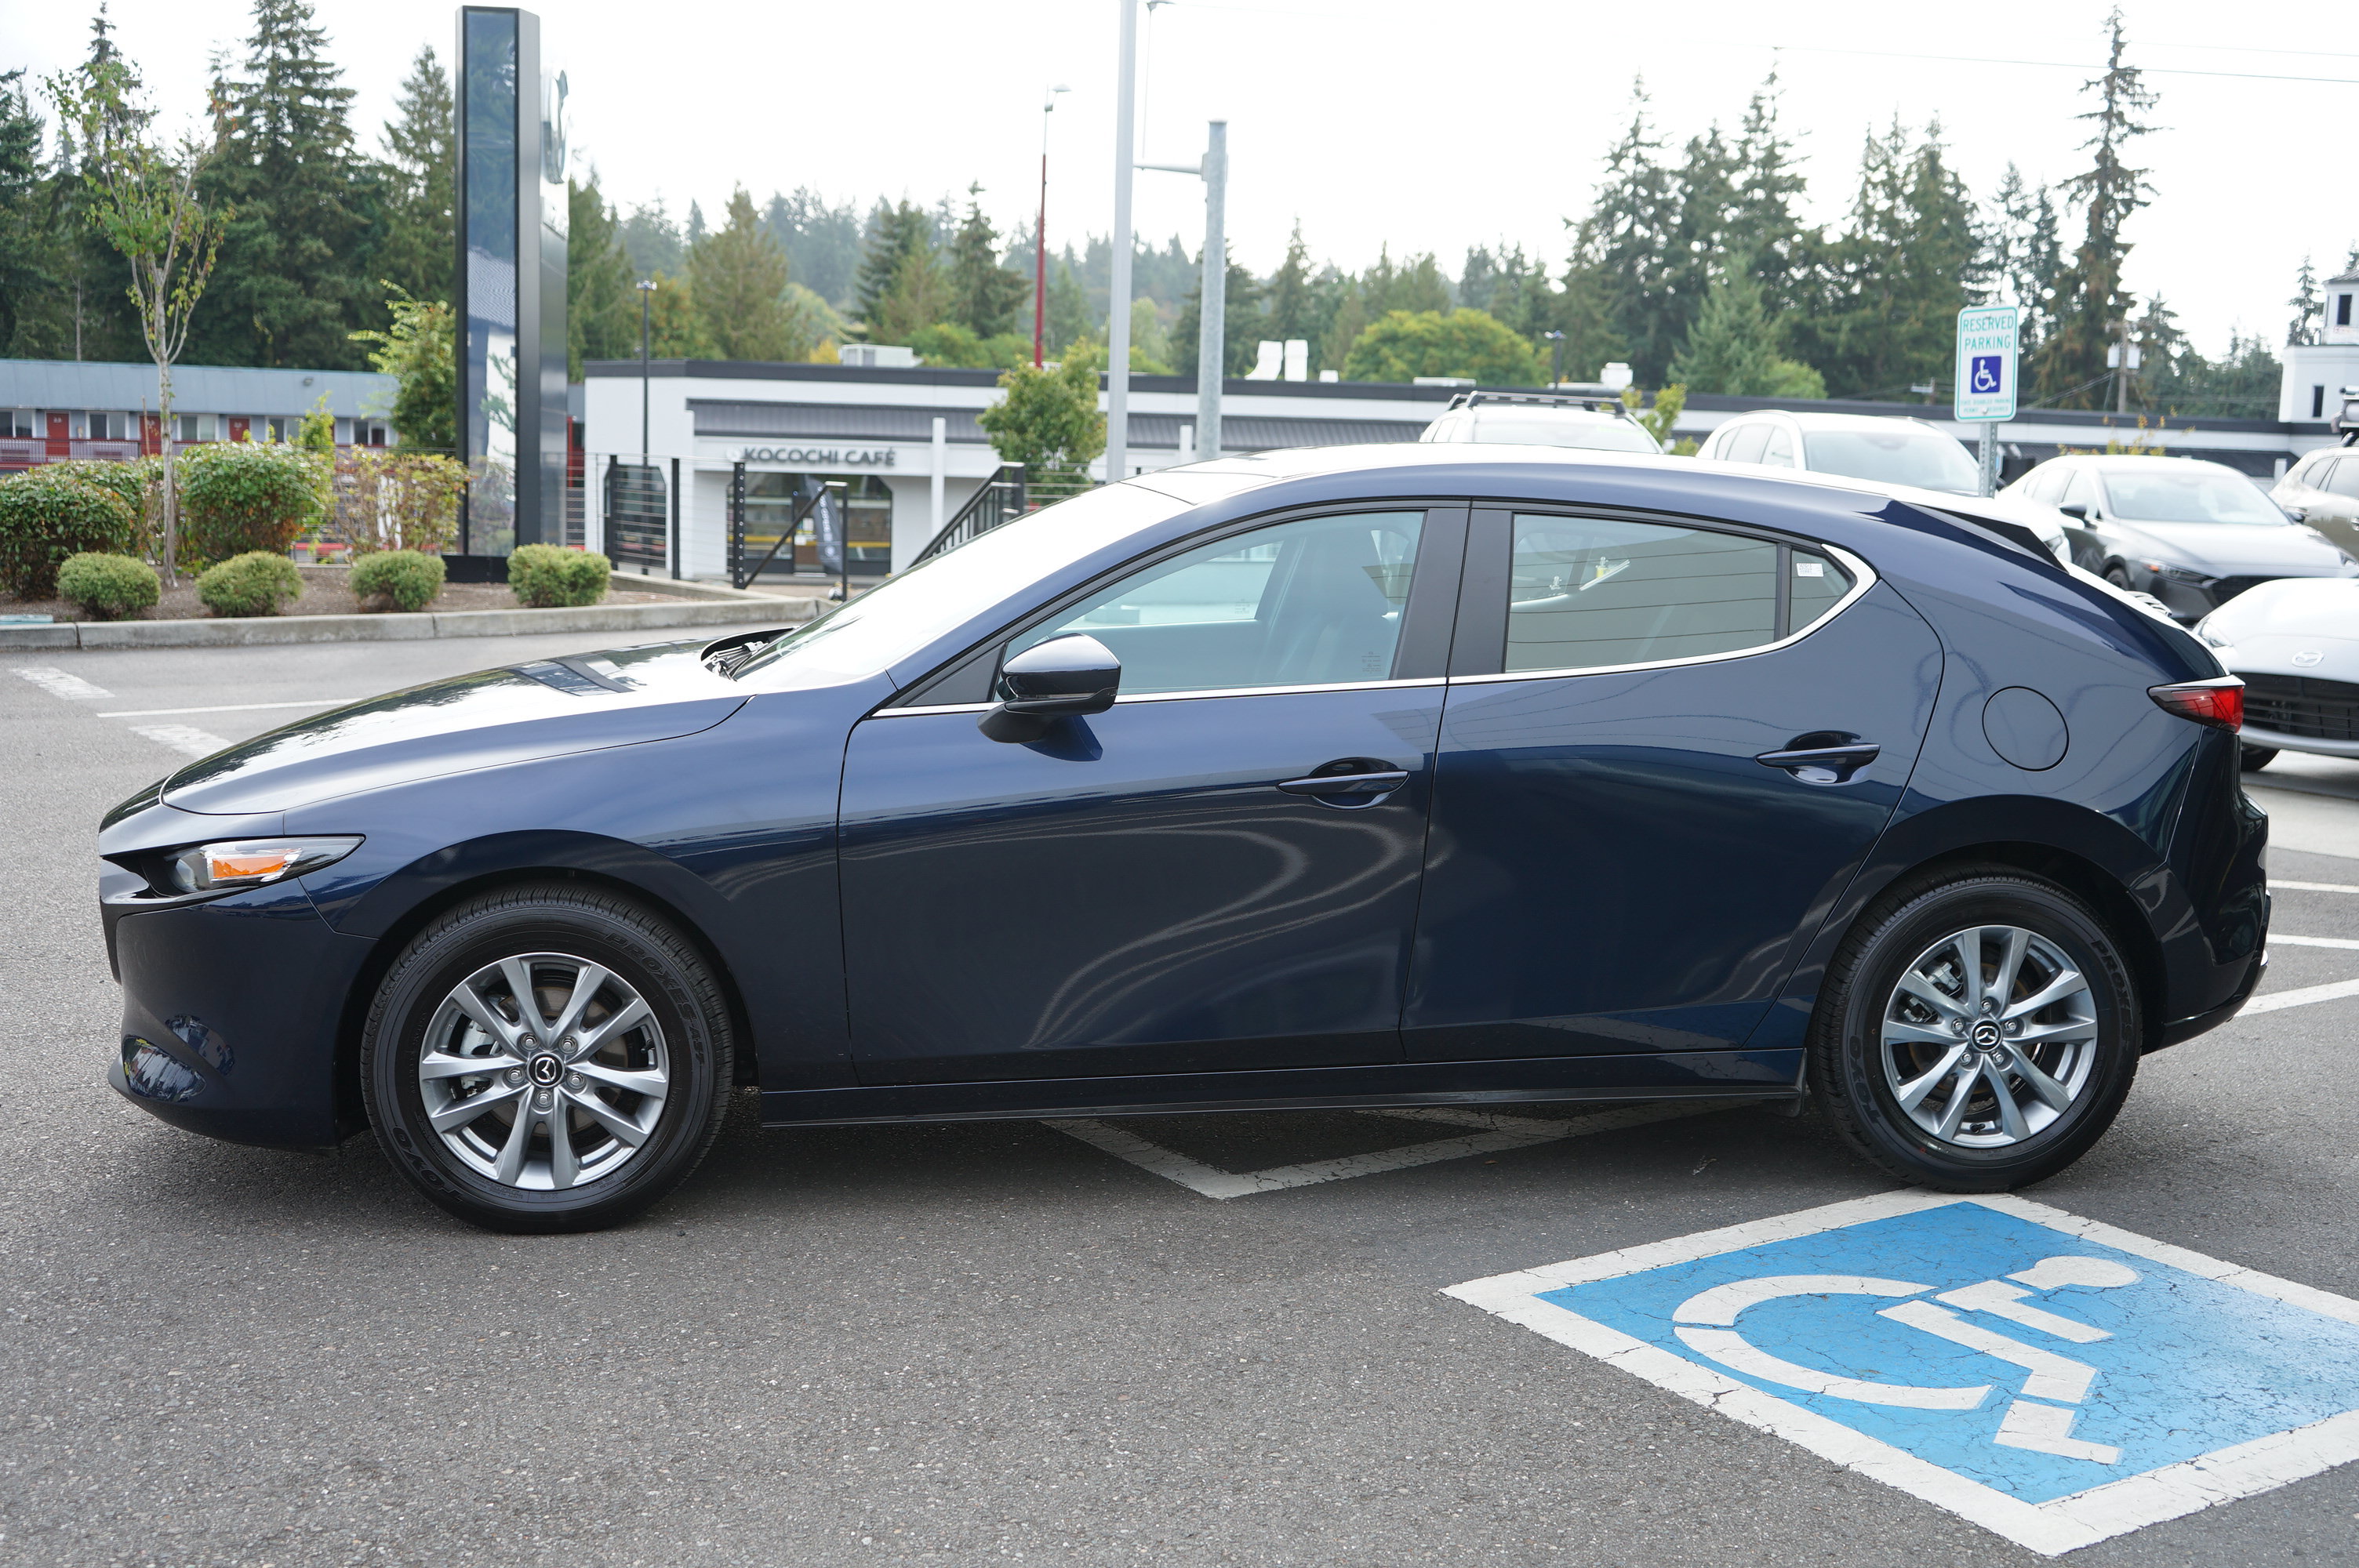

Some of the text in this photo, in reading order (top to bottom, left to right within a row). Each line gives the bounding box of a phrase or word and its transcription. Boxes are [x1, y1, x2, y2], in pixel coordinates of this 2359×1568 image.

[1963, 316, 2014, 332] RESERVED
[1965, 335, 2011, 351] PARKING
[744, 446, 896, 466] KOCOCHI CAFÉ
[605, 932, 697, 1020] PROXES
[1849, 1035, 1881, 1124] TOYO
[392, 1126, 464, 1203] TOYO
